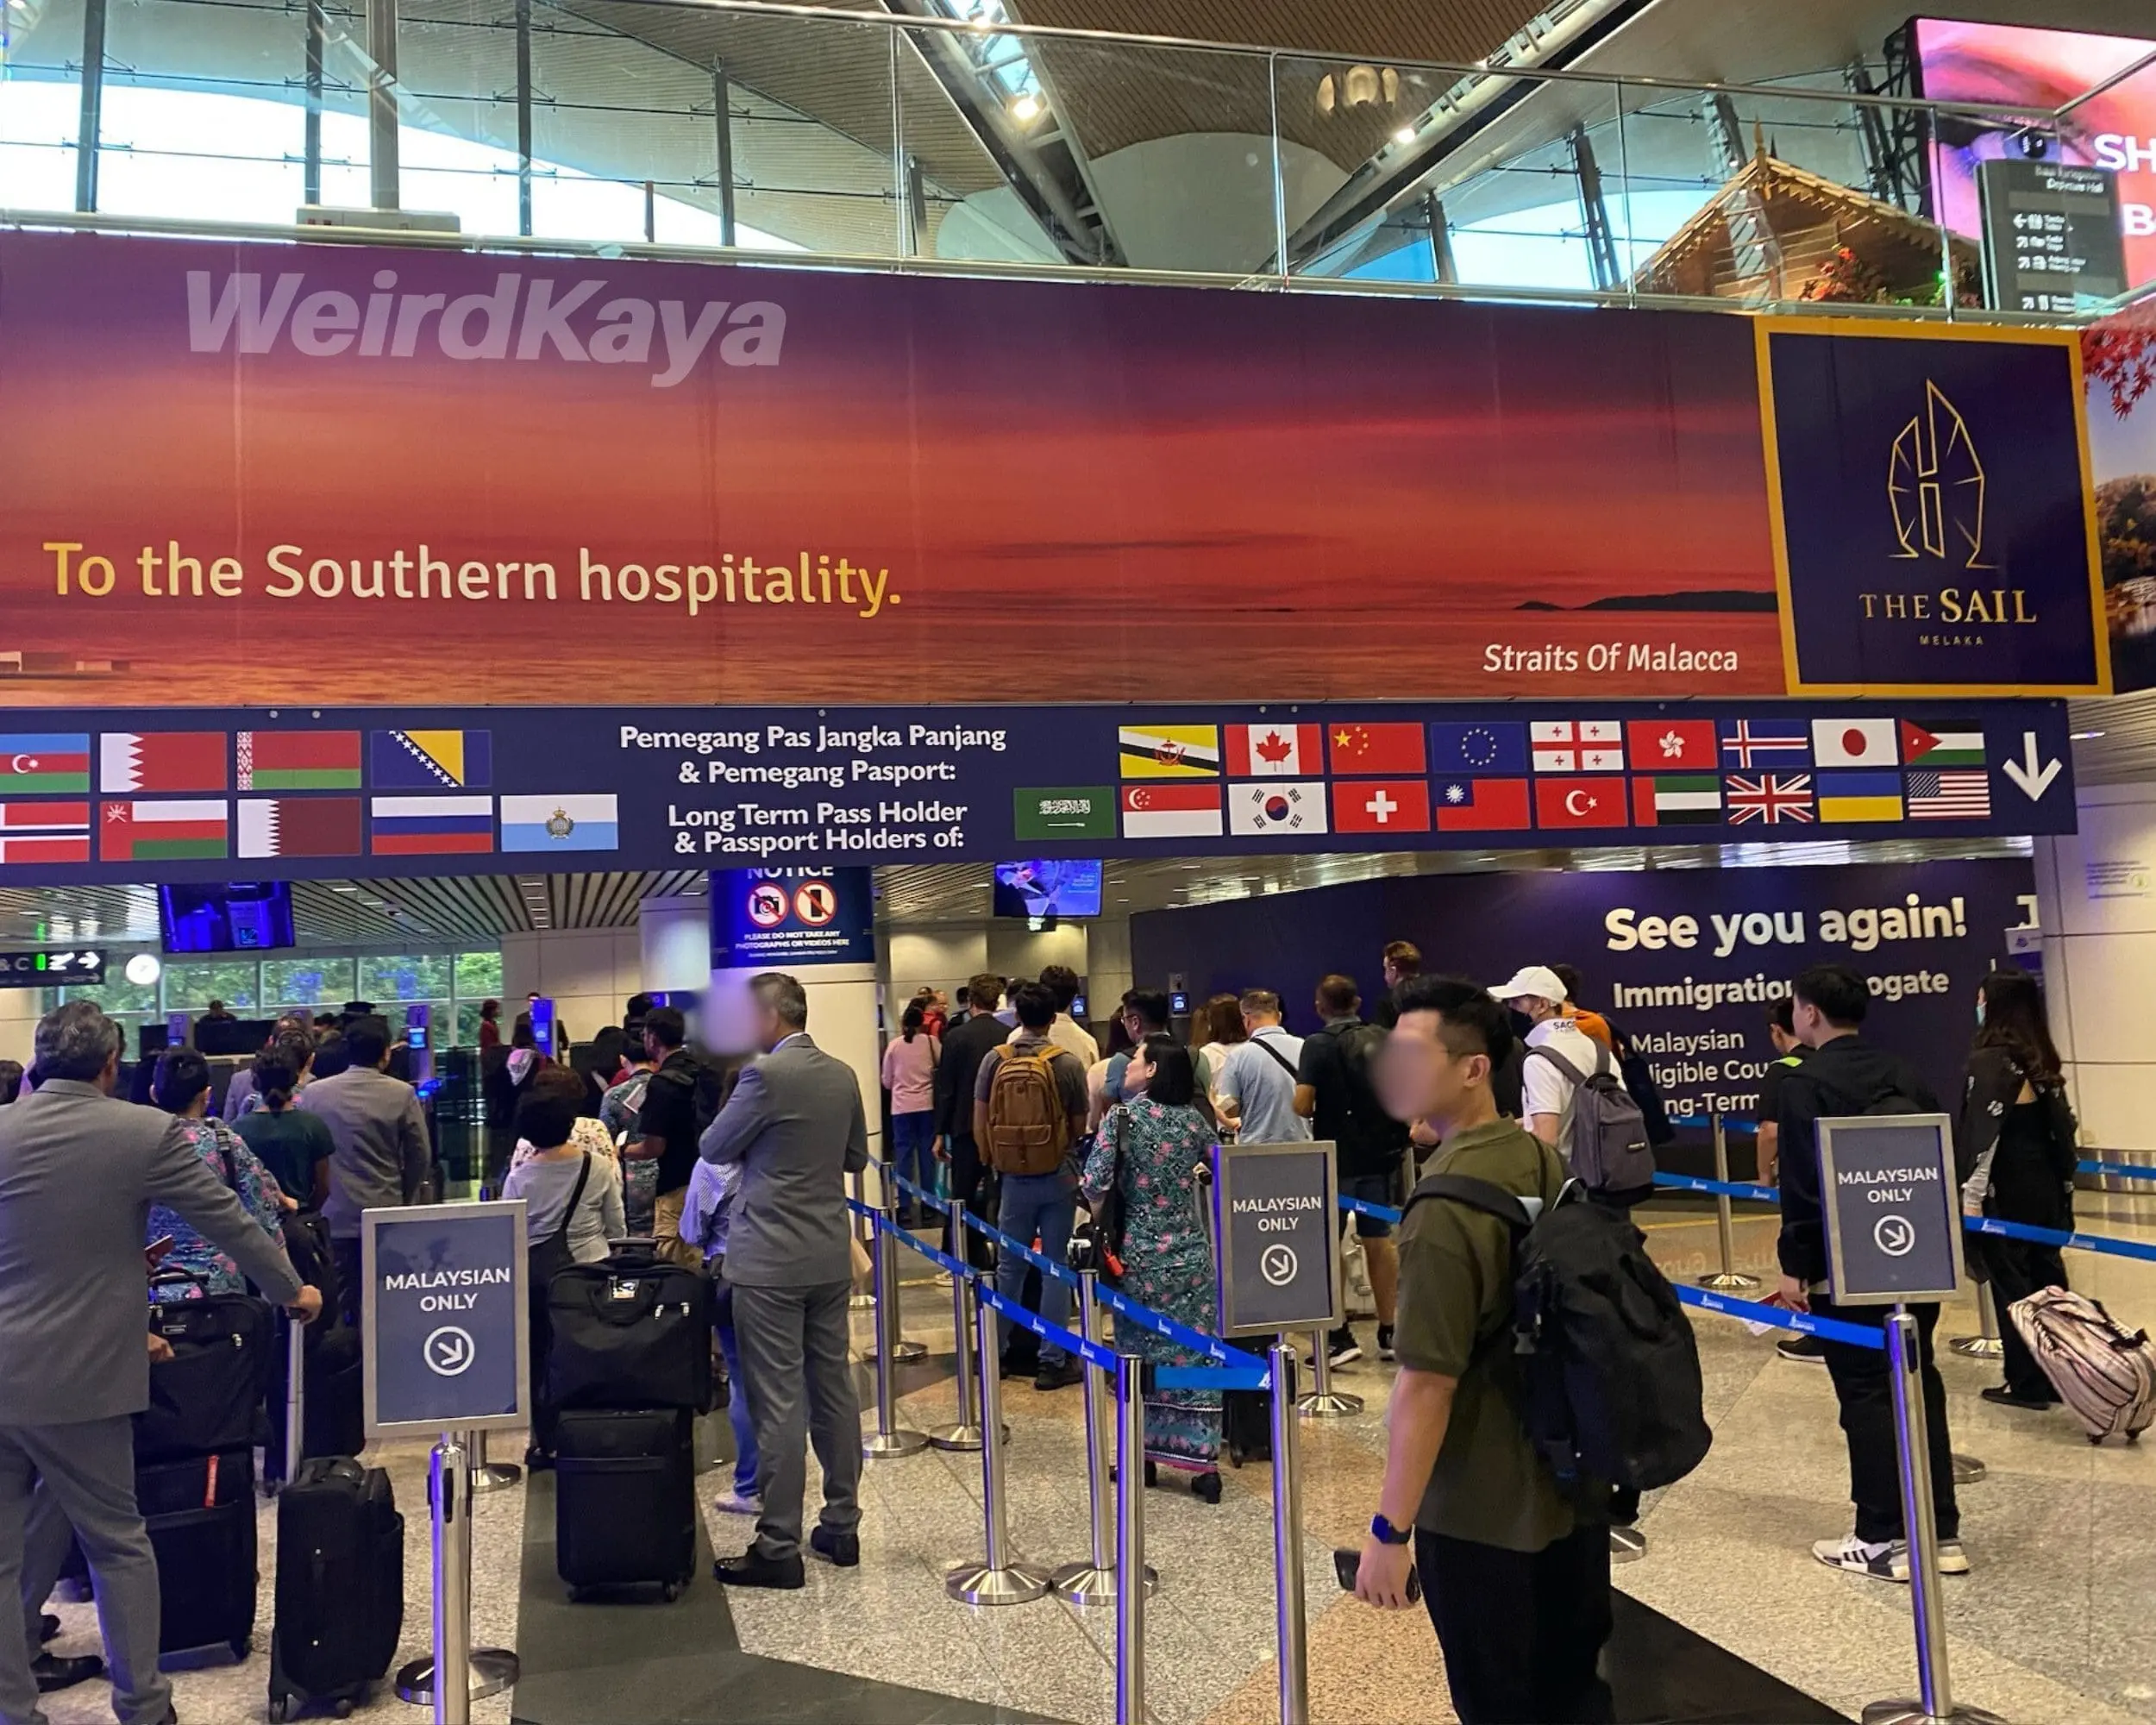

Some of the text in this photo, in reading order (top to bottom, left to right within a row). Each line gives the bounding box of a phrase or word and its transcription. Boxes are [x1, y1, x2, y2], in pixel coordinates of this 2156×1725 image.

[2122, 204, 2156, 235] B
[43, 540, 902, 619] To the Southern hospitality.
[1858, 588, 2037, 623] THE SAIL
[1919, 635, 1984, 645] MELAKA
[1483, 642, 1739, 673] Straits Of Malacca
[620, 724, 1007, 754] Pemegang Pas Jangka Panjang
[679, 760, 956, 787] & Pemegang Pasport:
[668, 800, 968, 832] Long Term Pass Holder
[674, 826, 964, 857] & Passport Holders of:
[1605, 893, 1967, 957] See you again!
[1865, 969, 1949, 1002] ogate
[1631, 1028, 1745, 1057] Malaysian
[1648, 1060, 1719, 1089] ligible
[1664, 1092, 1760, 1118] ng-Term
[1838, 1167, 1939, 1185] MALAYSIAN
[1233, 1196, 1322, 1214] MALAYSIAN
[1867, 1189, 1914, 1203] ONLY
[1257, 1217, 1299, 1232] ONLY
[385, 1267, 511, 1290] MALAYSIAN
[420, 1293, 479, 1312] ONLY
